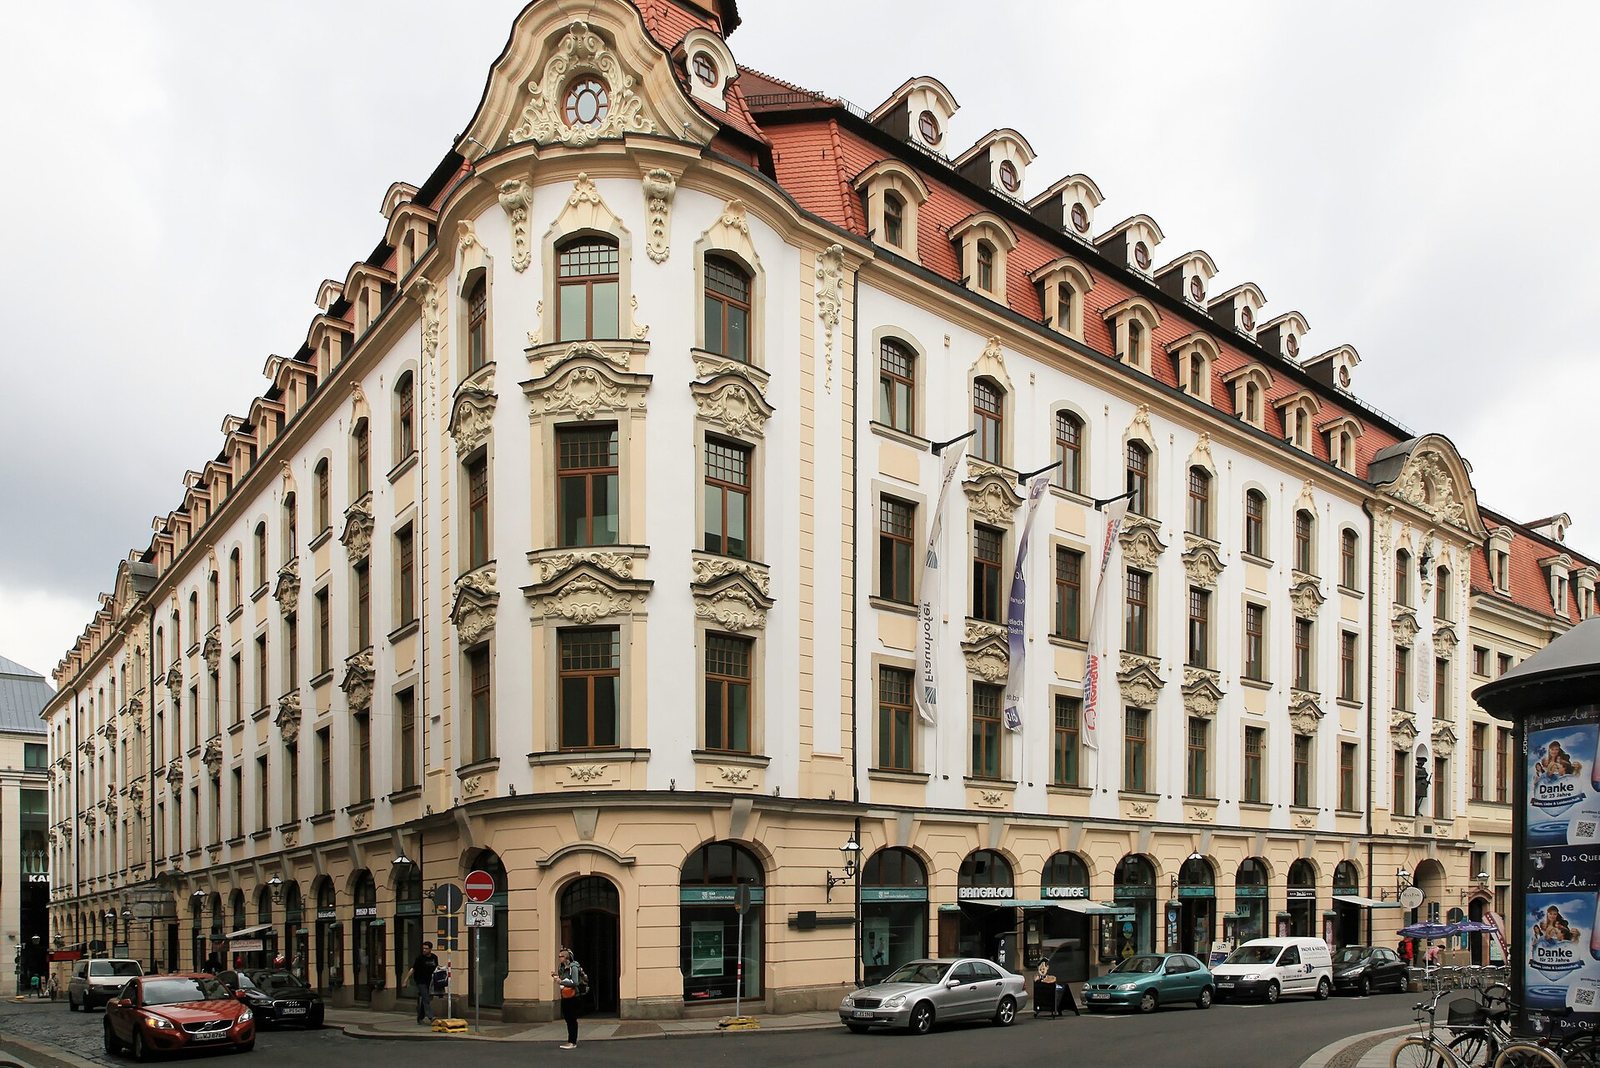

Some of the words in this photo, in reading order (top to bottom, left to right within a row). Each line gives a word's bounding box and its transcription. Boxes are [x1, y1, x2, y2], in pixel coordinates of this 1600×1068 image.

[1539, 782, 1574, 795] Danke
[1541, 880, 1565, 888] unsere
[1565, 875, 1586, 888] Art
[958, 887, 1013, 898] BANGALOU
[1046, 887, 1084, 898] LOUNGE
[1537, 948, 1573, 958] Danke
